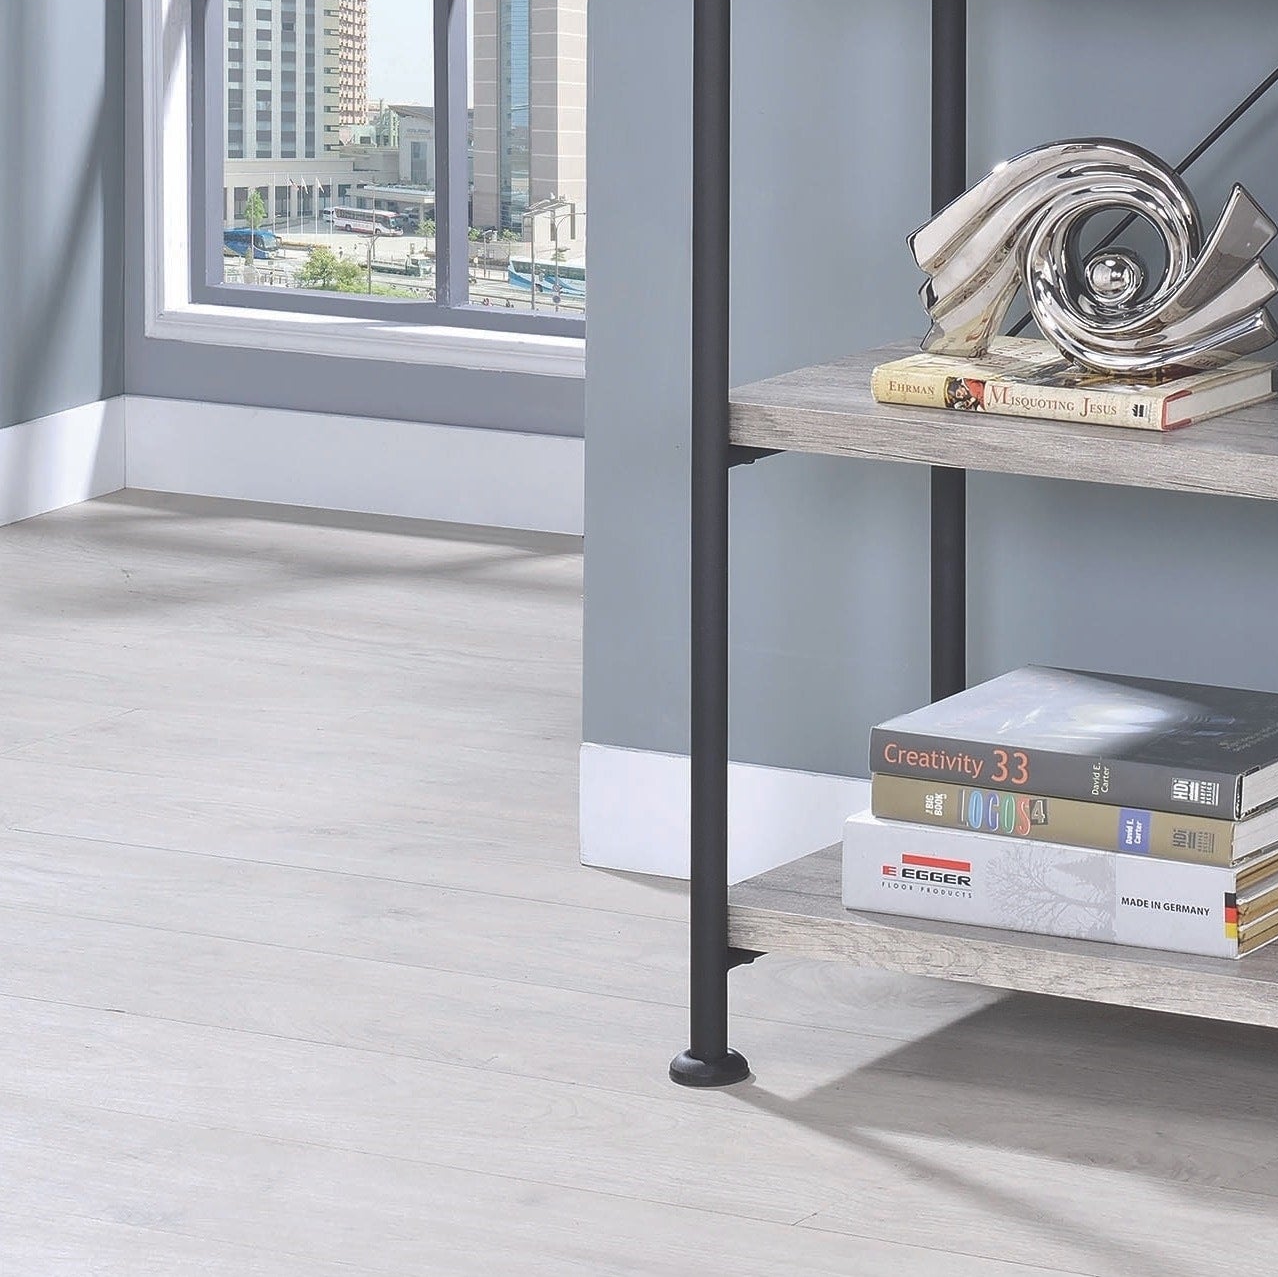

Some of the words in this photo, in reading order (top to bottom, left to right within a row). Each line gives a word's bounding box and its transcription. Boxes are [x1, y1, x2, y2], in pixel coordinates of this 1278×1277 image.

[888, 380, 934, 396] EHRMAN
[987, 385, 1075, 413] MISQUOTING
[1079, 397, 1117, 417] JESUS
[884, 742, 984, 779] Creativity
[991, 749, 1030, 785] 33
[1091, 771, 1101, 796] David
[1100, 766, 1110, 793] Carter
[925, 794, 934, 810] BIG
[934, 793, 944, 817] BOOK
[1133, 820, 1142, 845] Carter
[902, 868, 972, 887] EGGER
[882, 881, 913, 891] FLOOR
[920, 886, 972, 899] PRODUCTS
[1121, 897, 1149, 909] MADE
[1151, 901, 1161, 910] IN
[1163, 902, 1210, 916] GERMANY
